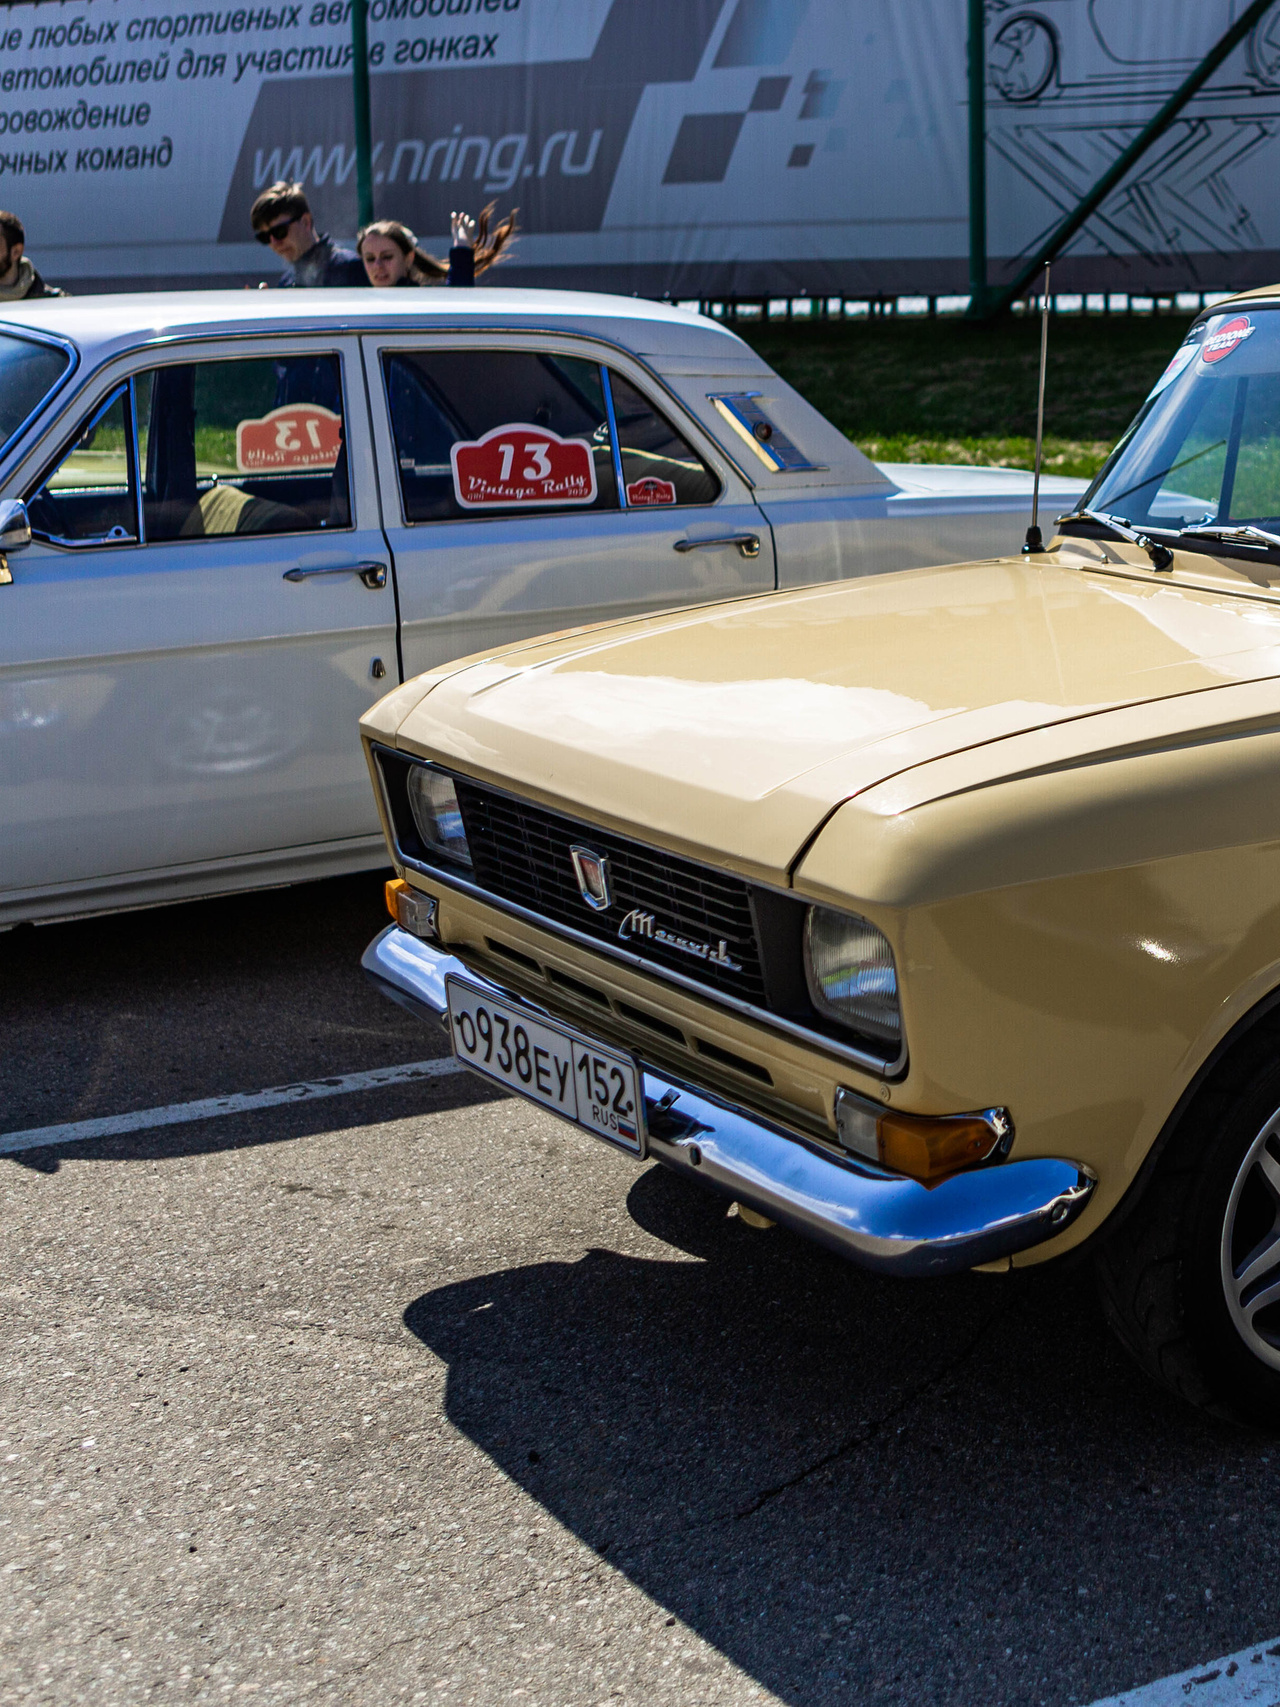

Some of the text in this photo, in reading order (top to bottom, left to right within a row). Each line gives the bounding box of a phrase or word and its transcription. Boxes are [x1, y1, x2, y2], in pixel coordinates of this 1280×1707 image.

[28, 16, 119, 50] любых
[125, 5, 302, 46] спортивных
[0, 51, 170, 92] втомобилей
[176, 47, 227, 80] для
[369, 41, 386, 66] в
[393, 33, 499, 65] гонках
[75, 135, 174, 172] команд
[498, 443, 552, 481] 13
[468, 475, 587, 499] Vintage Rally
[578, 1053, 628, 1117] 152
[592, 1104, 617, 1131] RUS
